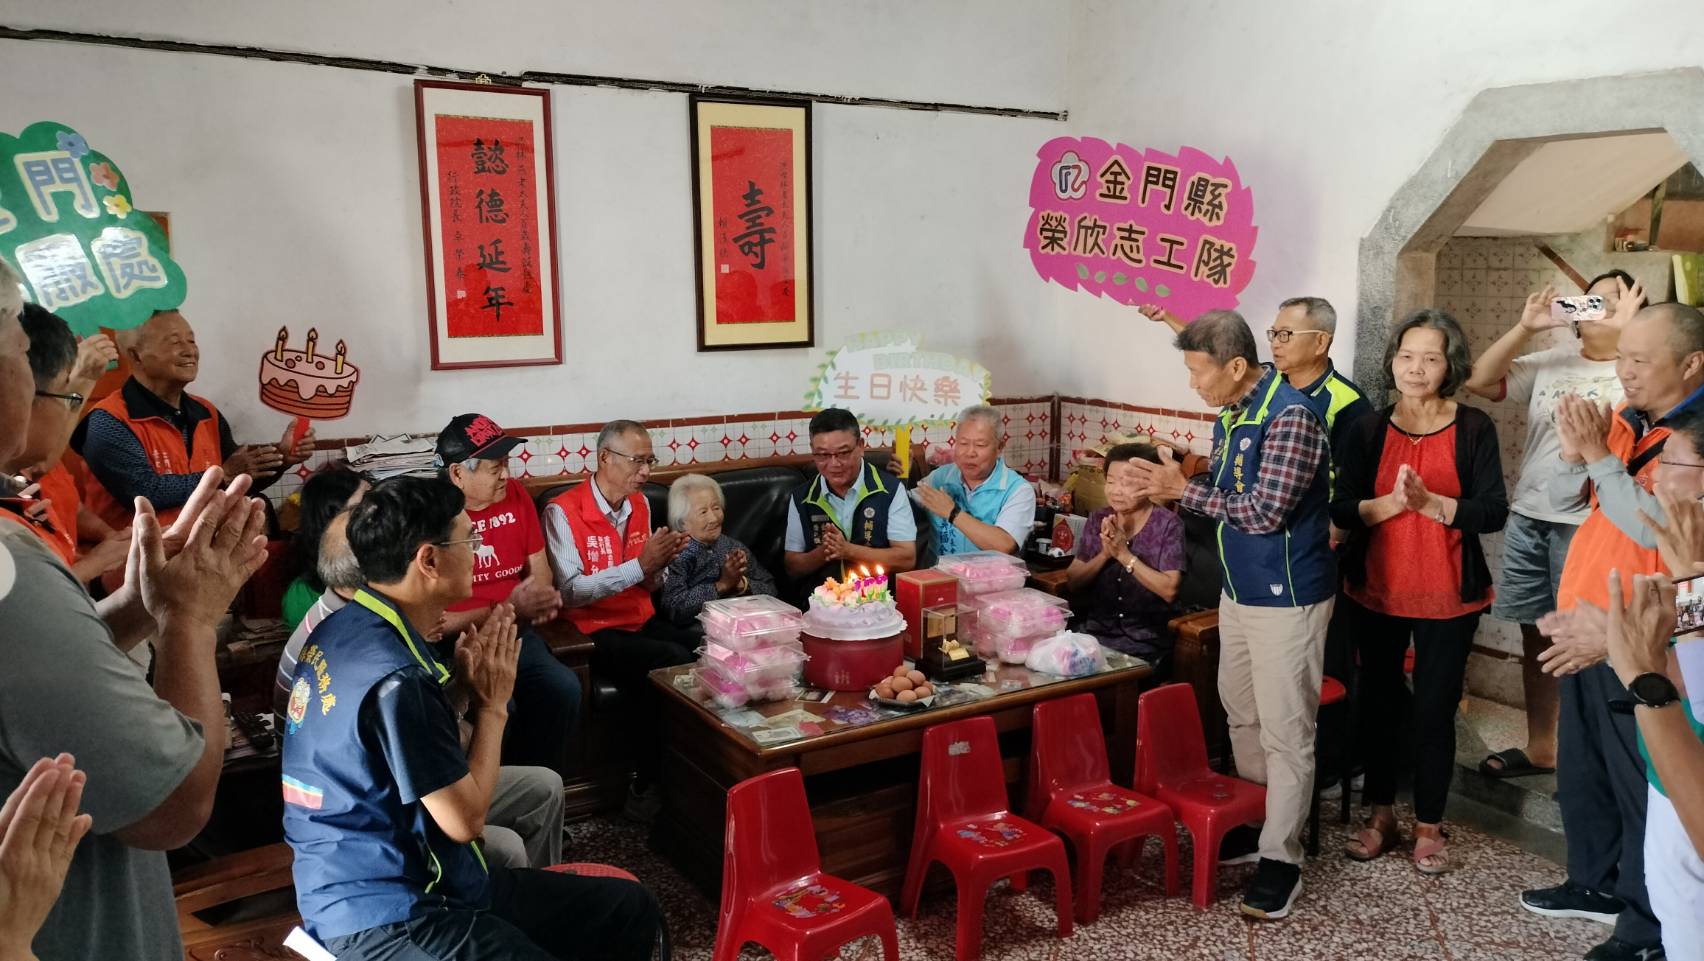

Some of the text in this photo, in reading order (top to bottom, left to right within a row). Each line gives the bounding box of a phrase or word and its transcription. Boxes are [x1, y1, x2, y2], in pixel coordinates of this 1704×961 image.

[0, 156, 94, 226] 門
[732, 180, 777, 270] 壽
[1099, 159, 1228, 223] 金門縣
[470, 138, 514, 322] 懿德延年
[1039, 212, 1236, 286] 榮欣志工隊
[833, 371, 961, 407] 生日快樂
